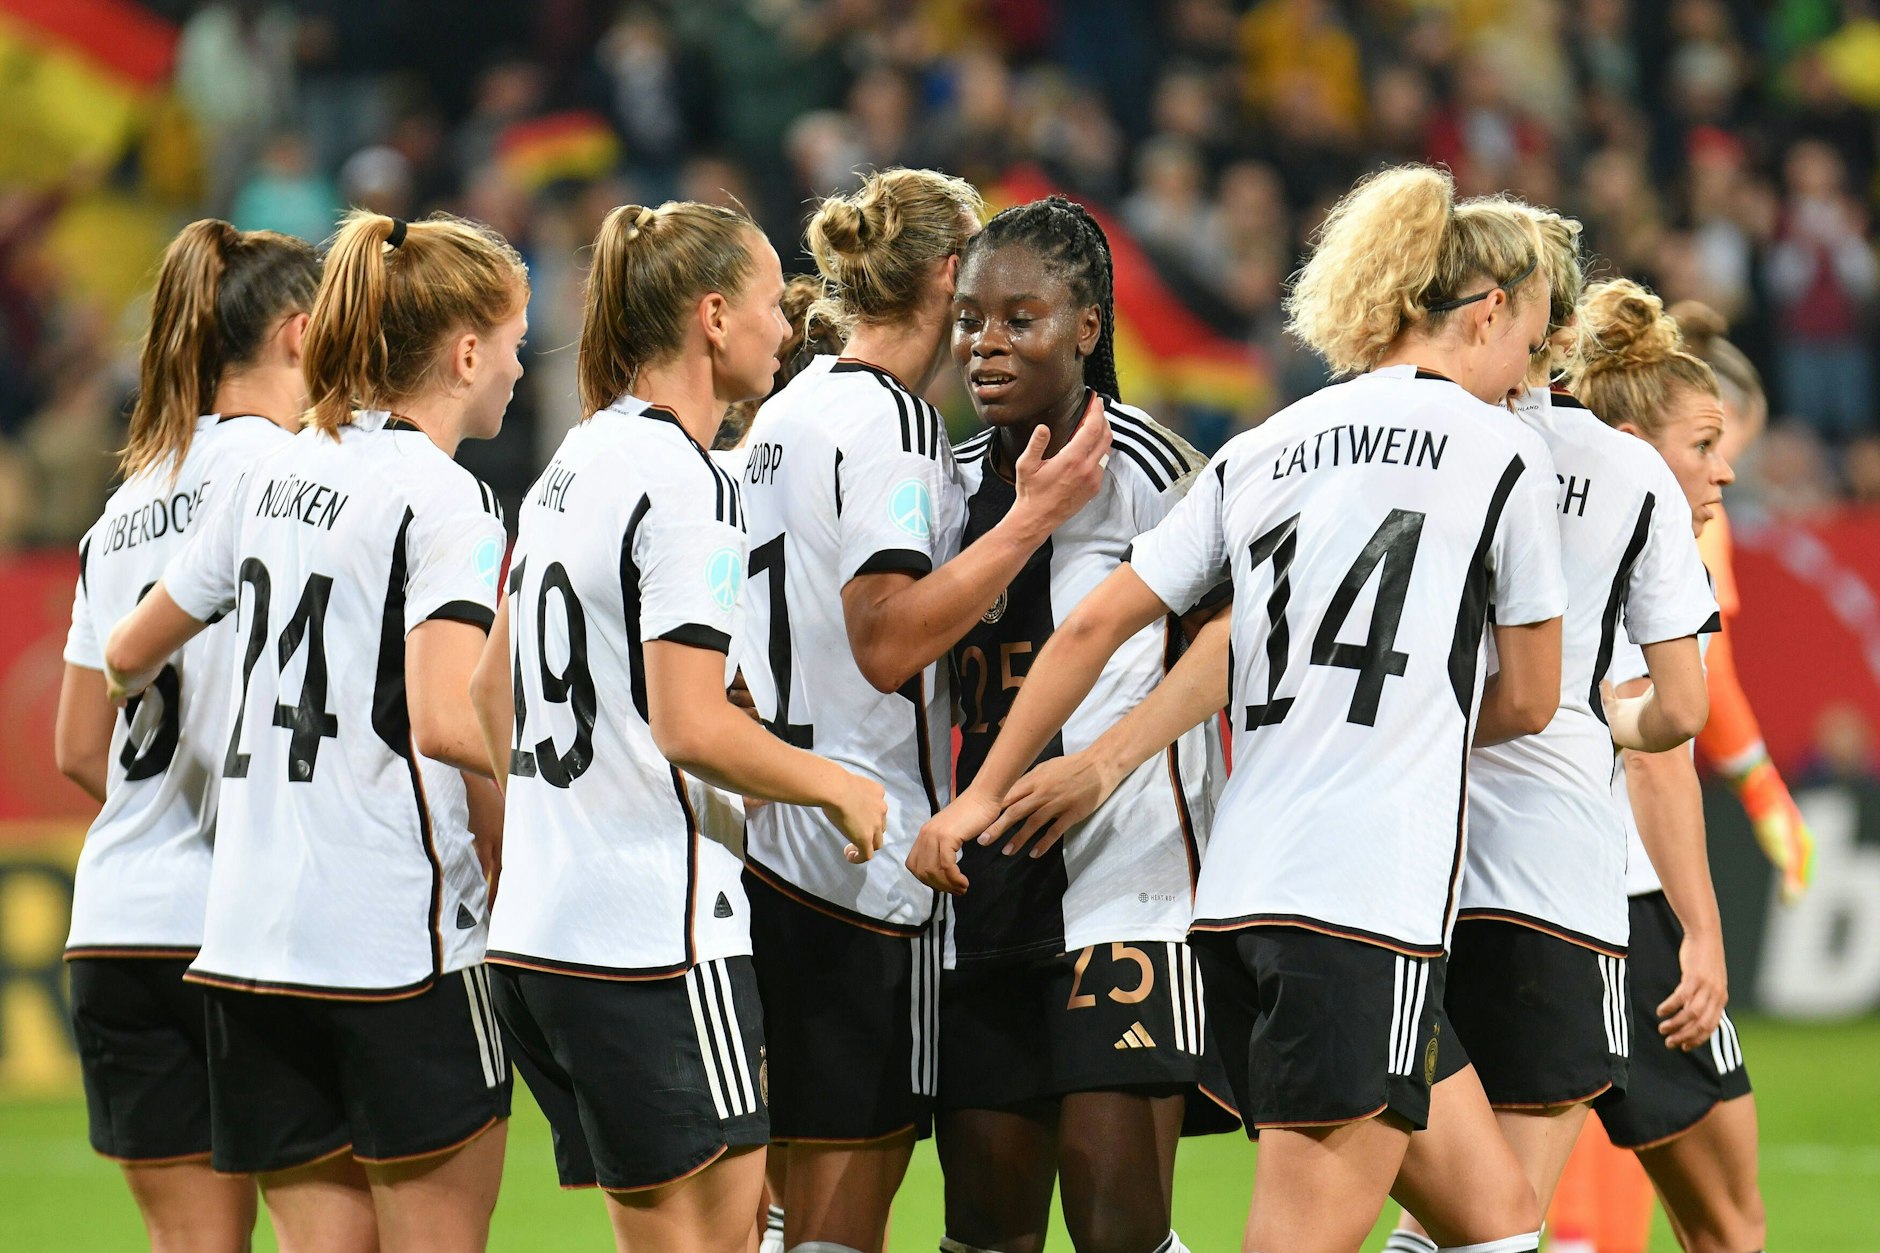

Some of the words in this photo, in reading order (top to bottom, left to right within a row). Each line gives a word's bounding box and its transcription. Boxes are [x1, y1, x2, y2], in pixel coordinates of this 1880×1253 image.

[537, 459, 577, 514] ÜHL
[743, 442, 783, 486] POPP
[1272, 424, 1449, 481] LATTWEIN
[256, 472, 349, 531] NÜSKEN
[747, 531, 814, 750] 1
[1244, 507, 1427, 732] 14
[222, 556, 339, 783] 24
[507, 553, 598, 789] 19
[1066, 941, 1155, 1012] 25
